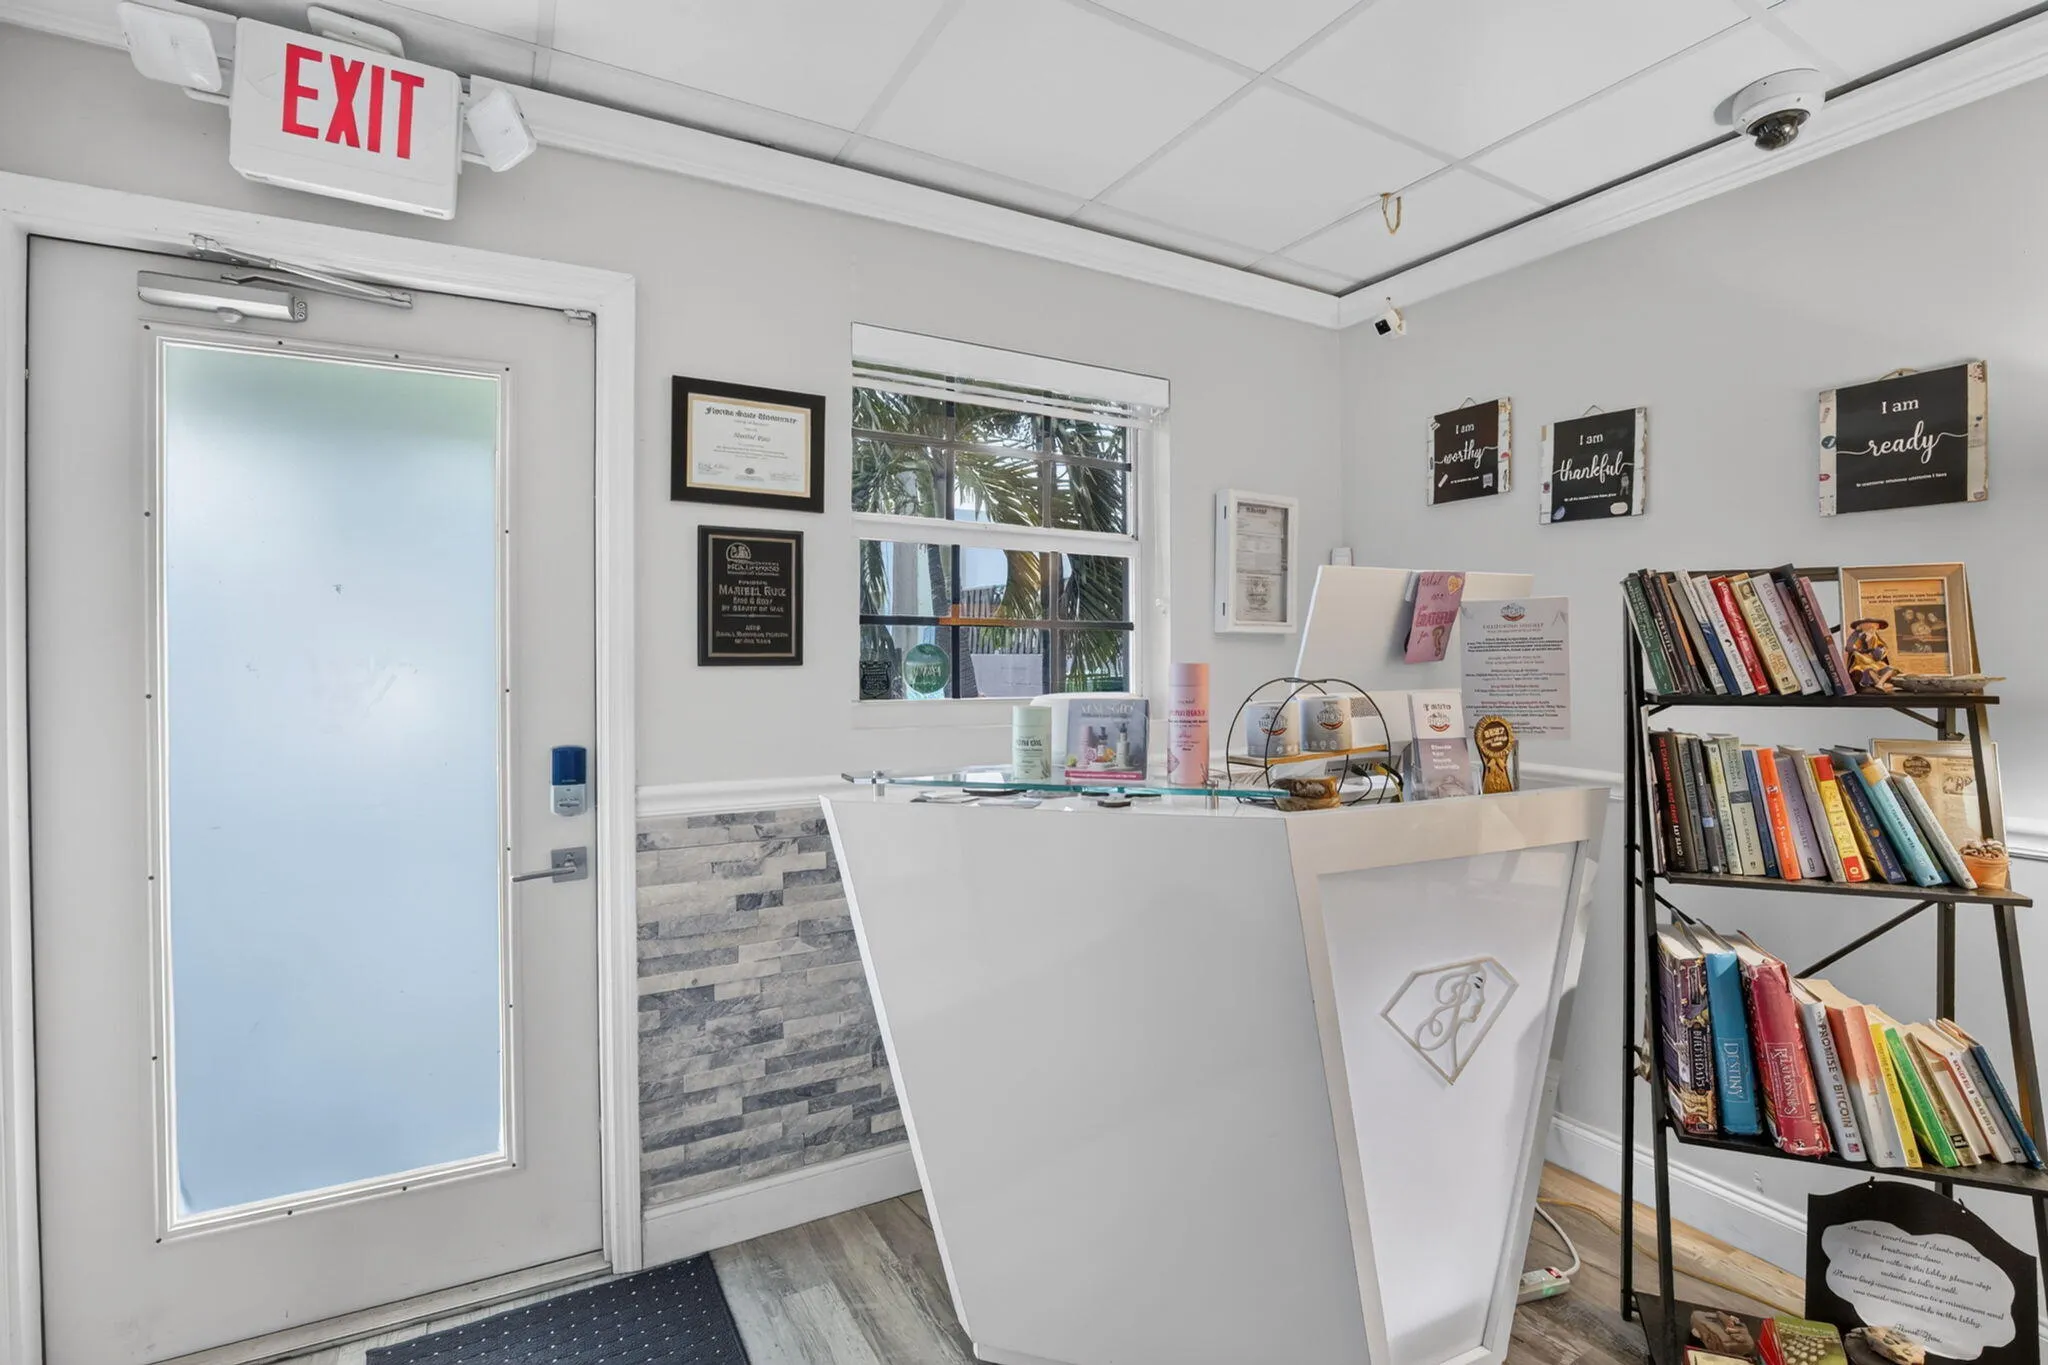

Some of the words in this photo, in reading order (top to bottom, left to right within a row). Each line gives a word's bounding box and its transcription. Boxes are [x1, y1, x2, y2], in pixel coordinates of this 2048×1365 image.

[282, 43, 424, 160] EXIT
[1881, 401, 1887, 414] I
[1892, 399, 1920, 412] am
[1456, 424, 1459, 435] I
[1460, 423, 1474, 434] am
[1580, 434, 1584, 446] I
[1586, 434, 1604, 445] am
[1868, 420, 1938, 464] ready
[1444, 439, 1484, 469] worthy
[1560, 450, 1624, 483] thankful
[1724, 1042, 1744, 1100] DESTINY
[1819, 1023, 1838, 1074] PROMISE
[1834, 1084, 1852, 1129] BITCOIN
